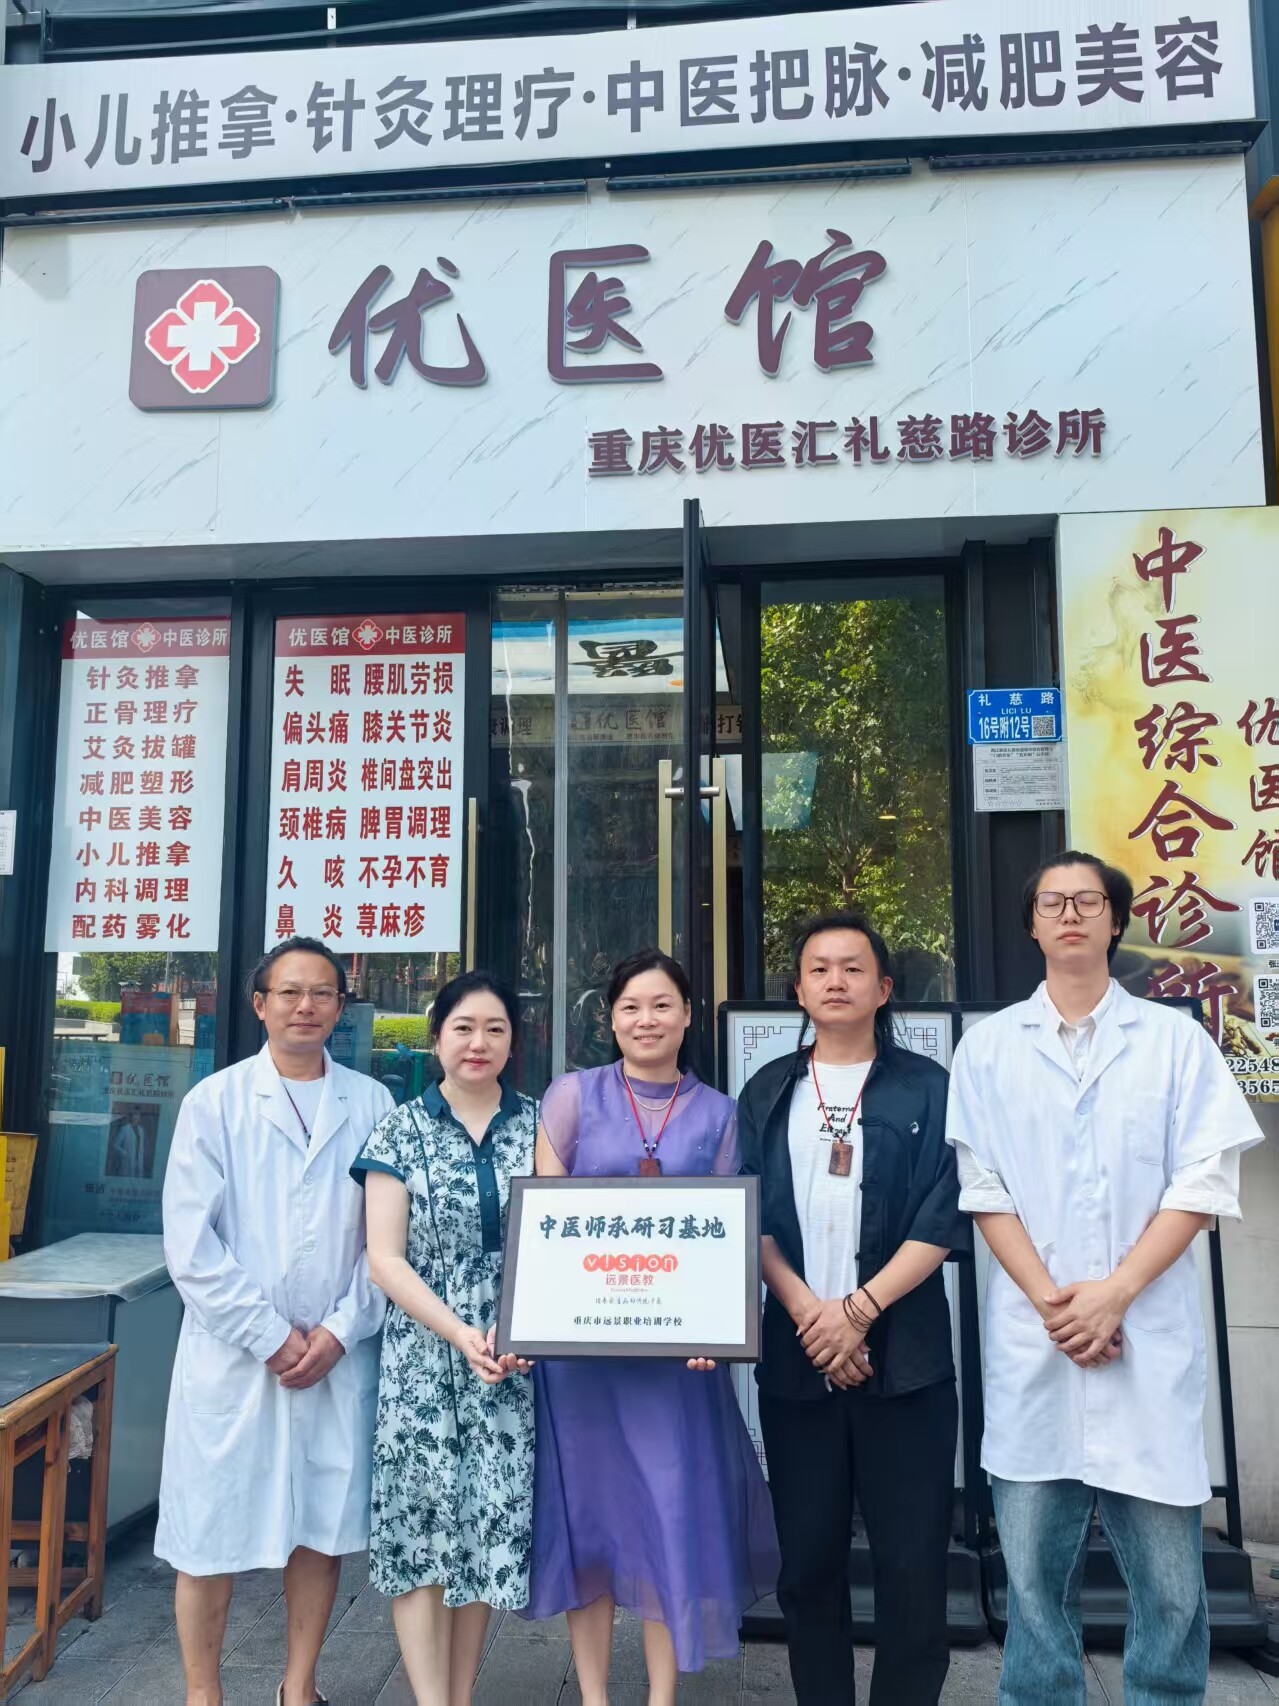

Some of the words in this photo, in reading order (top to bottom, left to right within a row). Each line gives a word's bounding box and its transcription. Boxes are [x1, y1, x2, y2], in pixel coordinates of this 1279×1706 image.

[20, 16, 1223, 173] 小儿推拿·针灸理疗·中医把脉·减肥美容
[328, 229, 887, 390] 优医馆
[588, 407, 1107, 477] 重庆优医汇礼慈路诊所
[70, 629, 130, 649] 优医馆
[162, 628, 228, 648] 中医诊所
[288, 627, 350, 647] 优医馆
[385, 624, 452, 645] 中医诊所
[86, 664, 199, 691] 针灸推拿
[363, 661, 453, 696] 腰肌劳损
[977, 692, 1054, 706] 礼慈路
[84, 700, 198, 726] 正骨理疗
[282, 710, 349, 745] 偏头痛
[362, 708, 452, 744] 膝关节炎
[978, 716, 1031, 739] 16号附12号
[82, 734, 197, 760] 艾灸拔罐
[79, 769, 194, 796] 减肥塑形
[281, 758, 348, 793] 肩周炎
[361, 756, 452, 792] 椎间盘突出
[1128, 526, 1243, 1048] 中医综合诊所
[78, 804, 192, 832] 中医美容
[279, 806, 346, 841] 颈椎病
[359, 804, 451, 840] 脾胃调理
[76, 840, 191, 867] 小儿推拿
[358, 853, 450, 889] 不孕不育
[74, 877, 189, 903] 内科调理
[71, 912, 191, 940] 配药雾化
[356, 902, 426, 938] 荨麻疹
[539, 1214, 726, 1239] 中医师承研习基地
[606, 1274, 654, 1286] 远景医教
[574, 1315, 683, 1327] 重庆市远景职业培训学校
